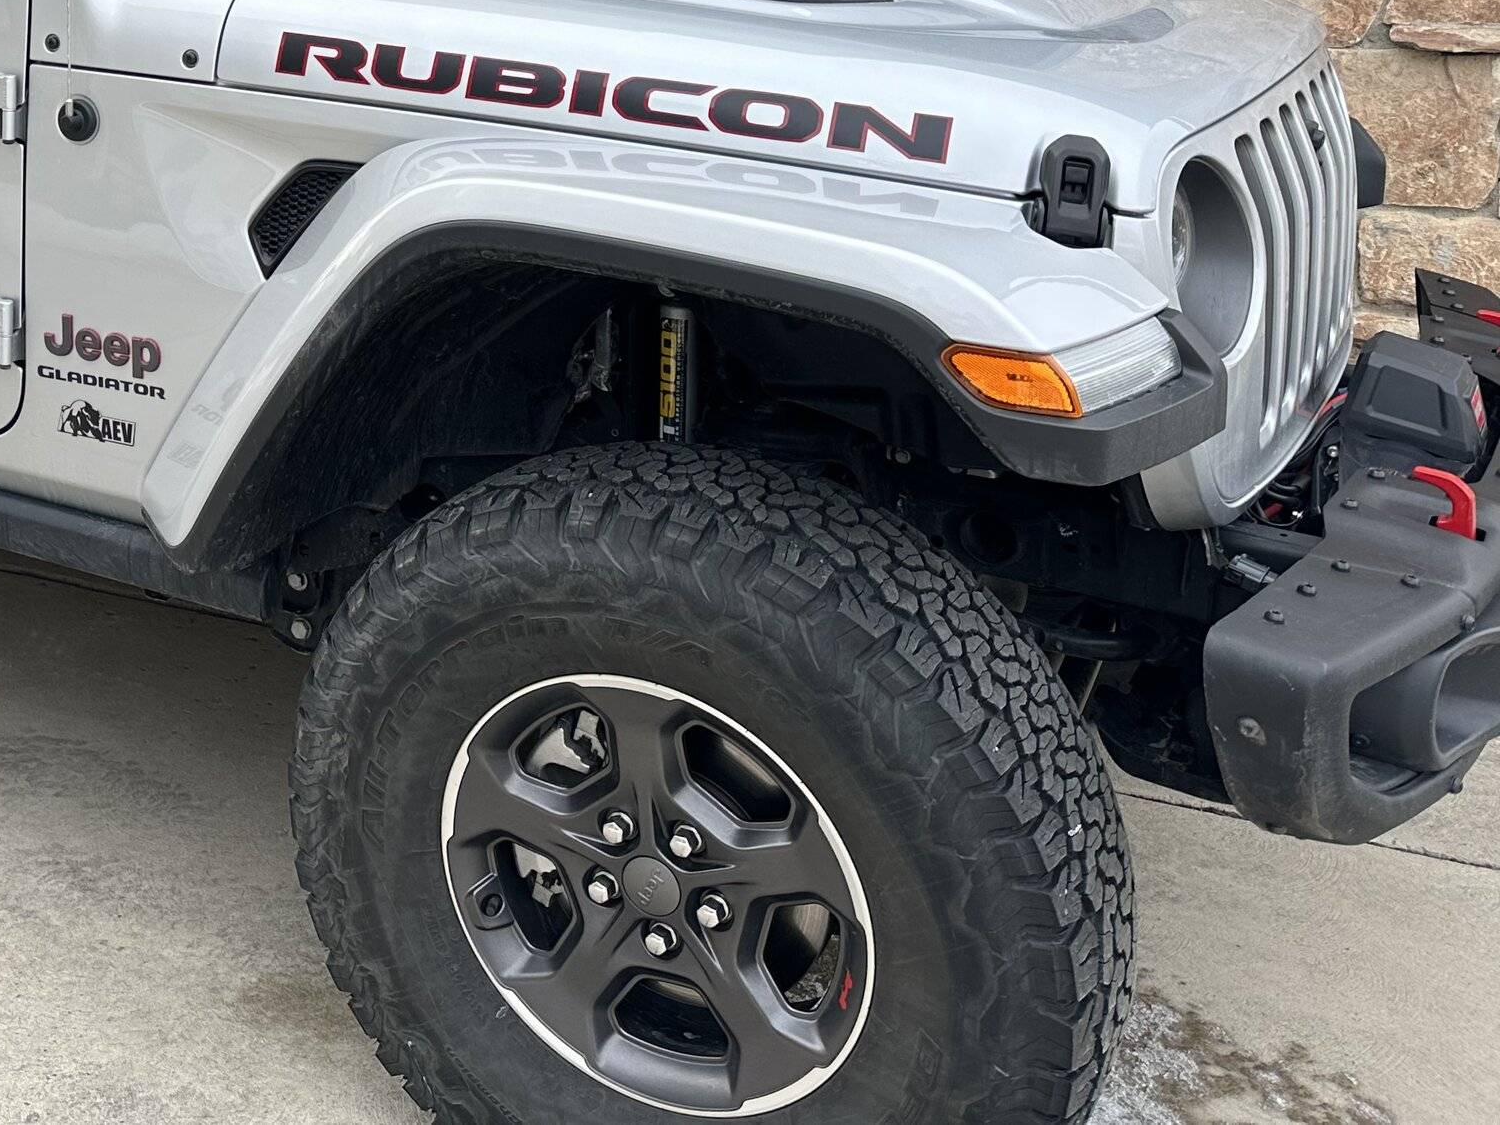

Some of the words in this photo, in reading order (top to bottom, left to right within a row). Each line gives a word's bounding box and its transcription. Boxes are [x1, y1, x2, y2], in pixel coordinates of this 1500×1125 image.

[274, 31, 954, 164] RUBICON
[44, 313, 161, 379] Jeep
[37, 365, 166, 400] GLADIATOR
[101, 418, 135, 444] AEV
